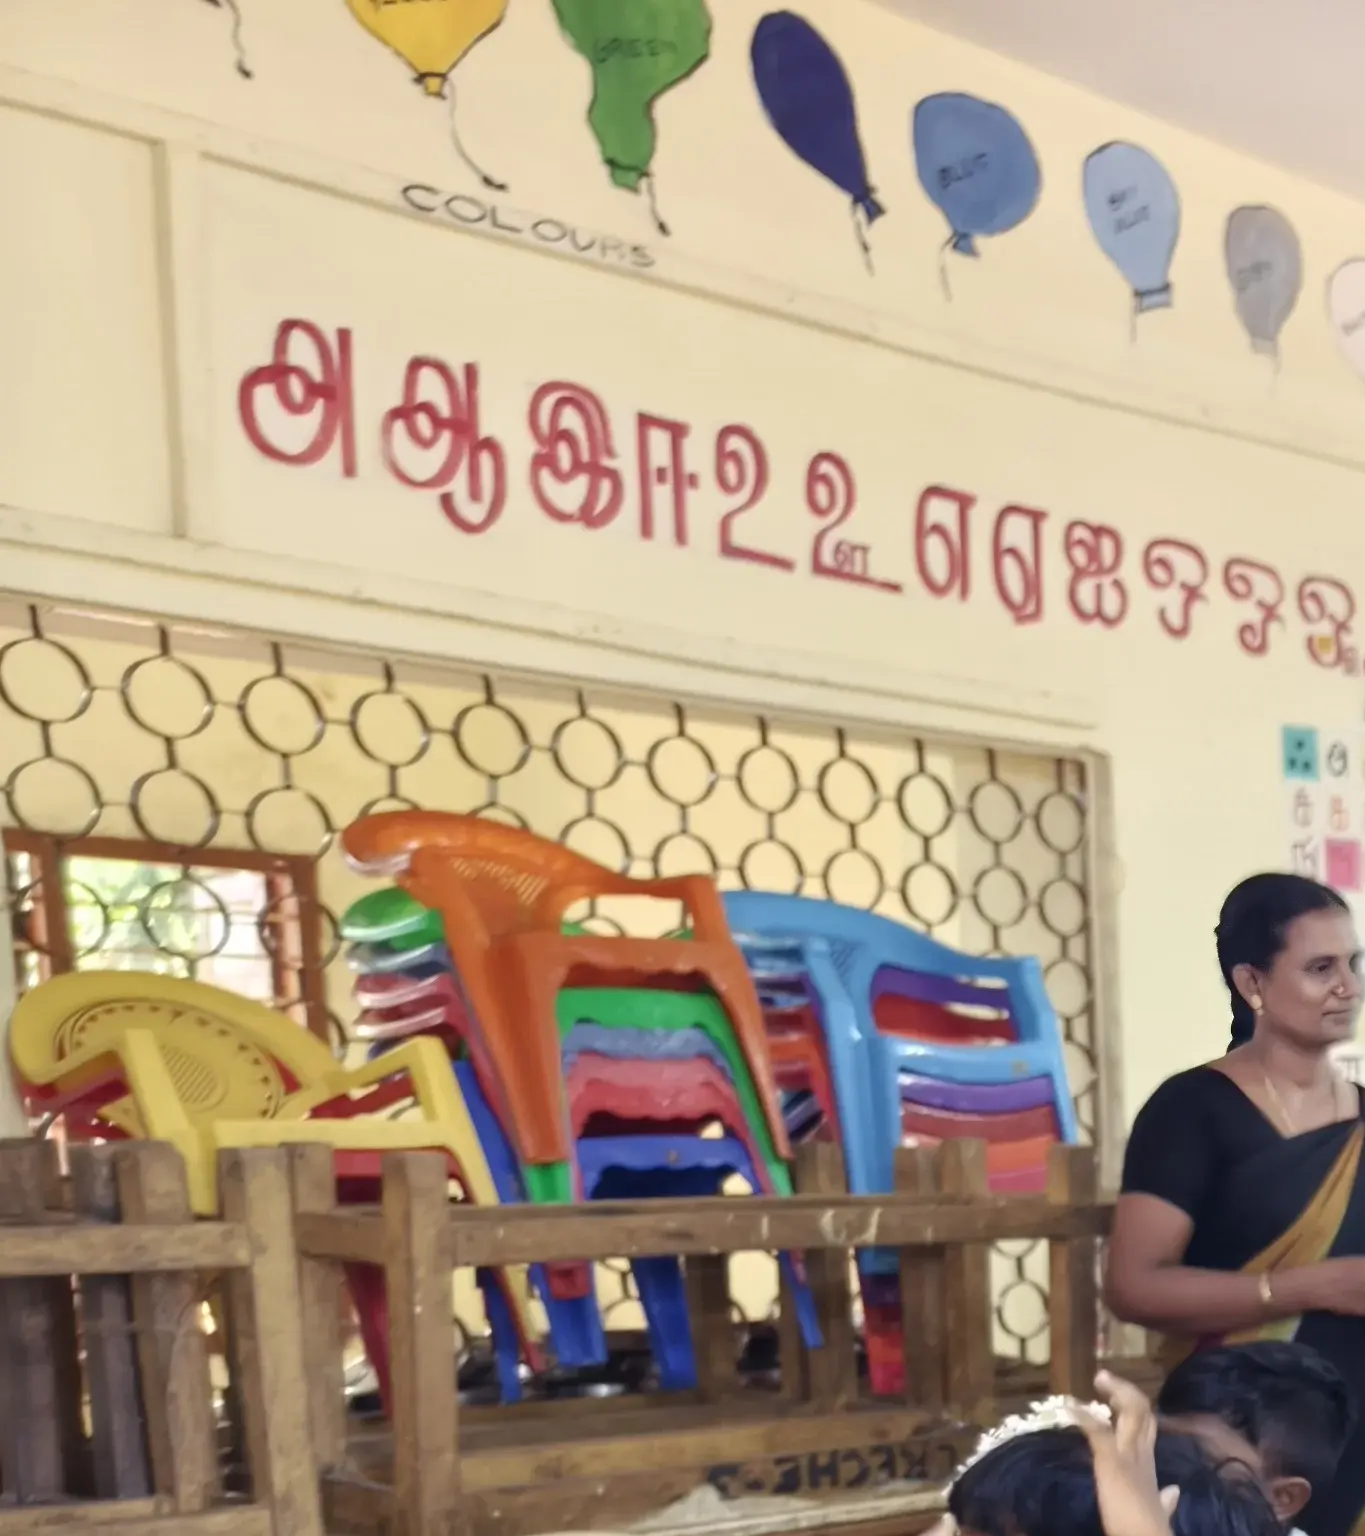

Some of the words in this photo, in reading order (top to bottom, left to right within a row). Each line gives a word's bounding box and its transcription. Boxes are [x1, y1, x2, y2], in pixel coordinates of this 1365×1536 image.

[237, 317, 357, 481] அ
[381, 354, 507, 535] ஆ
[528, 379, 624, 531] இ
[636, 410, 700, 548] ஈ
[716, 423, 795, 572] உ
[805, 450, 904, 594] ஊ
[914, 484, 978, 602] எ
[993, 503, 1049, 625] ஏ
[1063, 518, 1128, 629] ஐ
